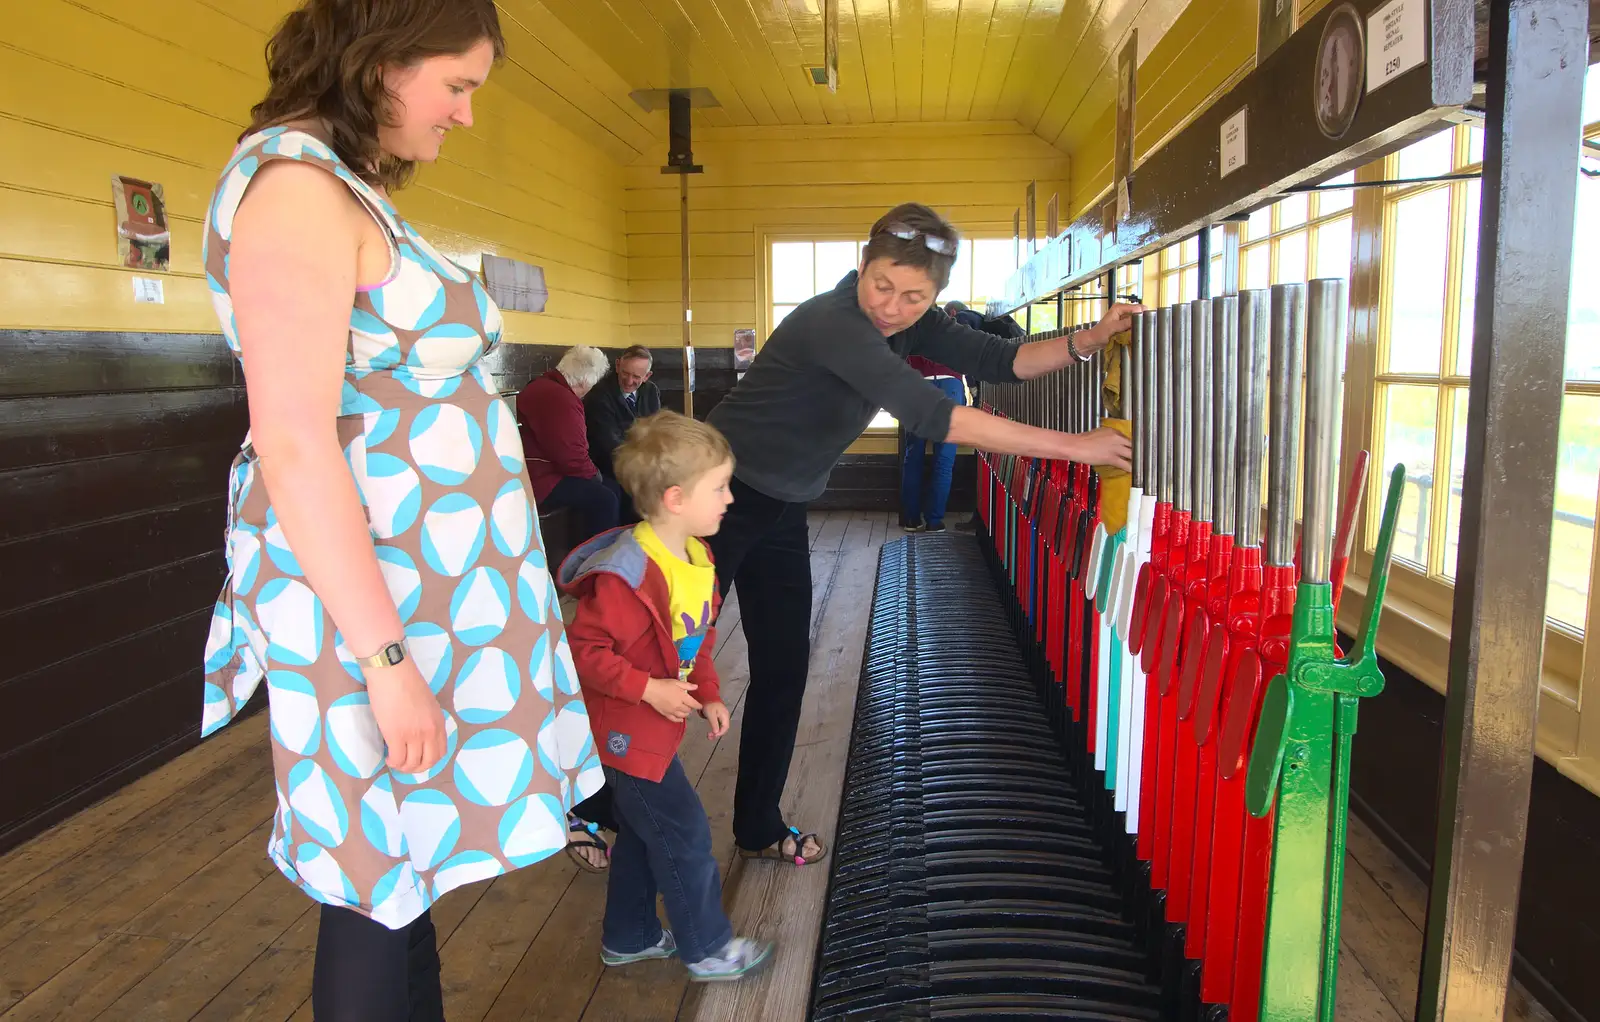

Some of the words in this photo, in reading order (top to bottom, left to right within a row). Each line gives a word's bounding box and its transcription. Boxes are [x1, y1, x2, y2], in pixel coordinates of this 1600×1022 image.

[1385, 15, 1402, 32] DISTANT
[1385, 26, 1401, 41] SIGNAL
[1383, 34, 1403, 52] REPEATER
[1385, 56, 1401, 76] £250
